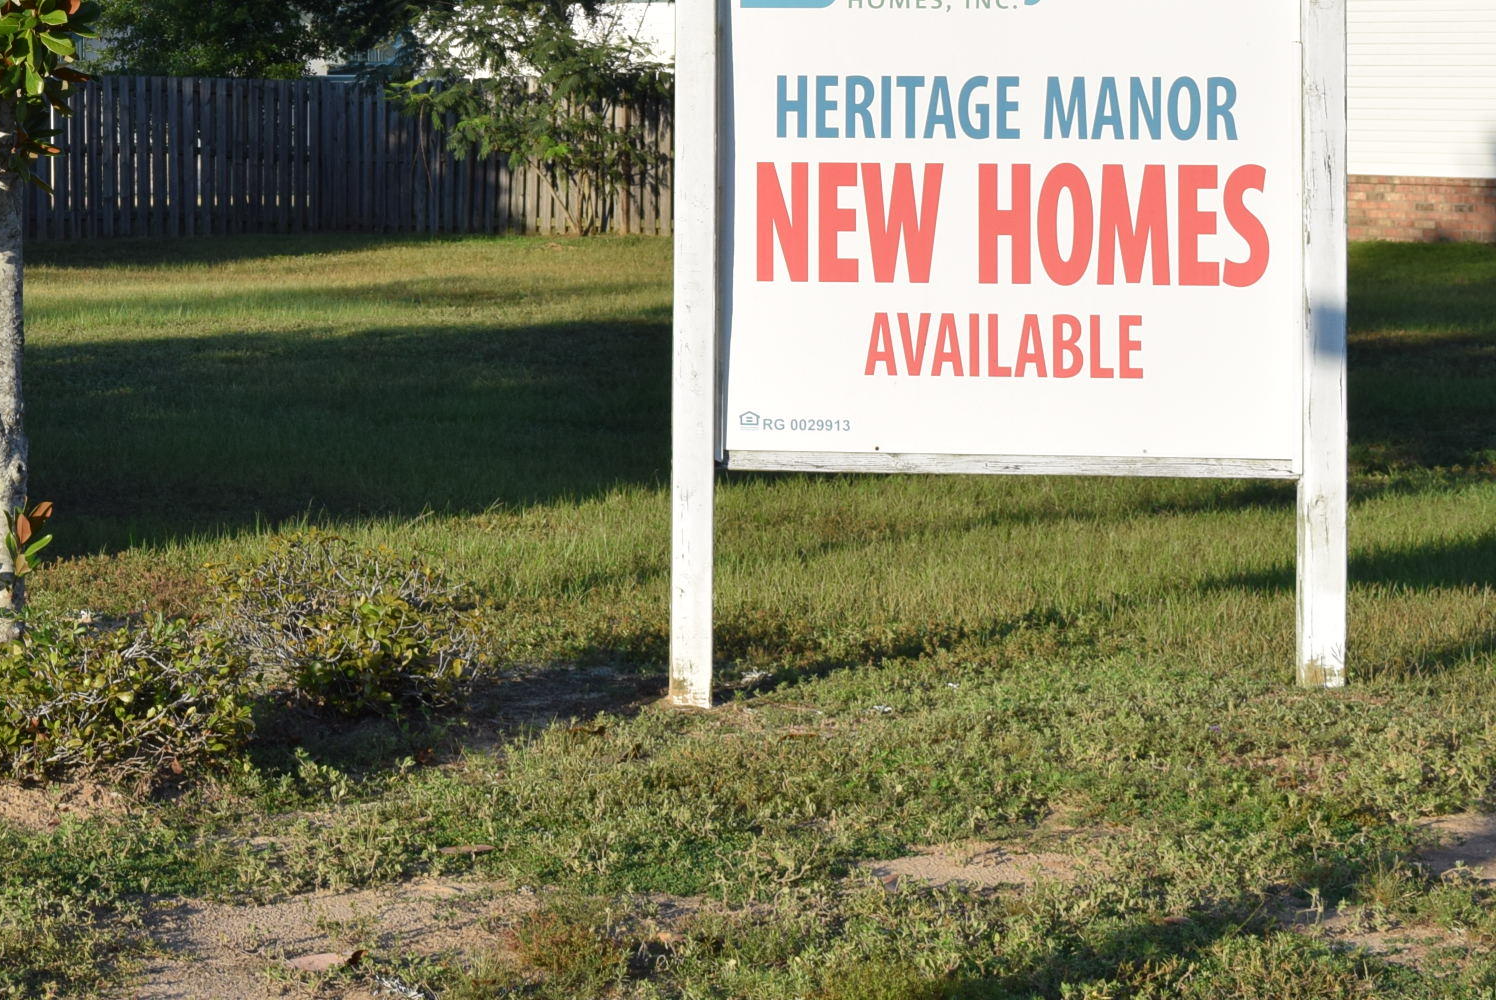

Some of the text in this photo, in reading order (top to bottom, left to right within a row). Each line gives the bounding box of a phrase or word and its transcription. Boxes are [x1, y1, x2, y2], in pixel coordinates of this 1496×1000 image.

[775, 74, 1239, 141] HERITAGE MANOR
[755, 161, 1271, 288] NEW HOMES
[863, 311, 1144, 380] AVAILABLE
[762, 418, 851, 432] RG 0029913
